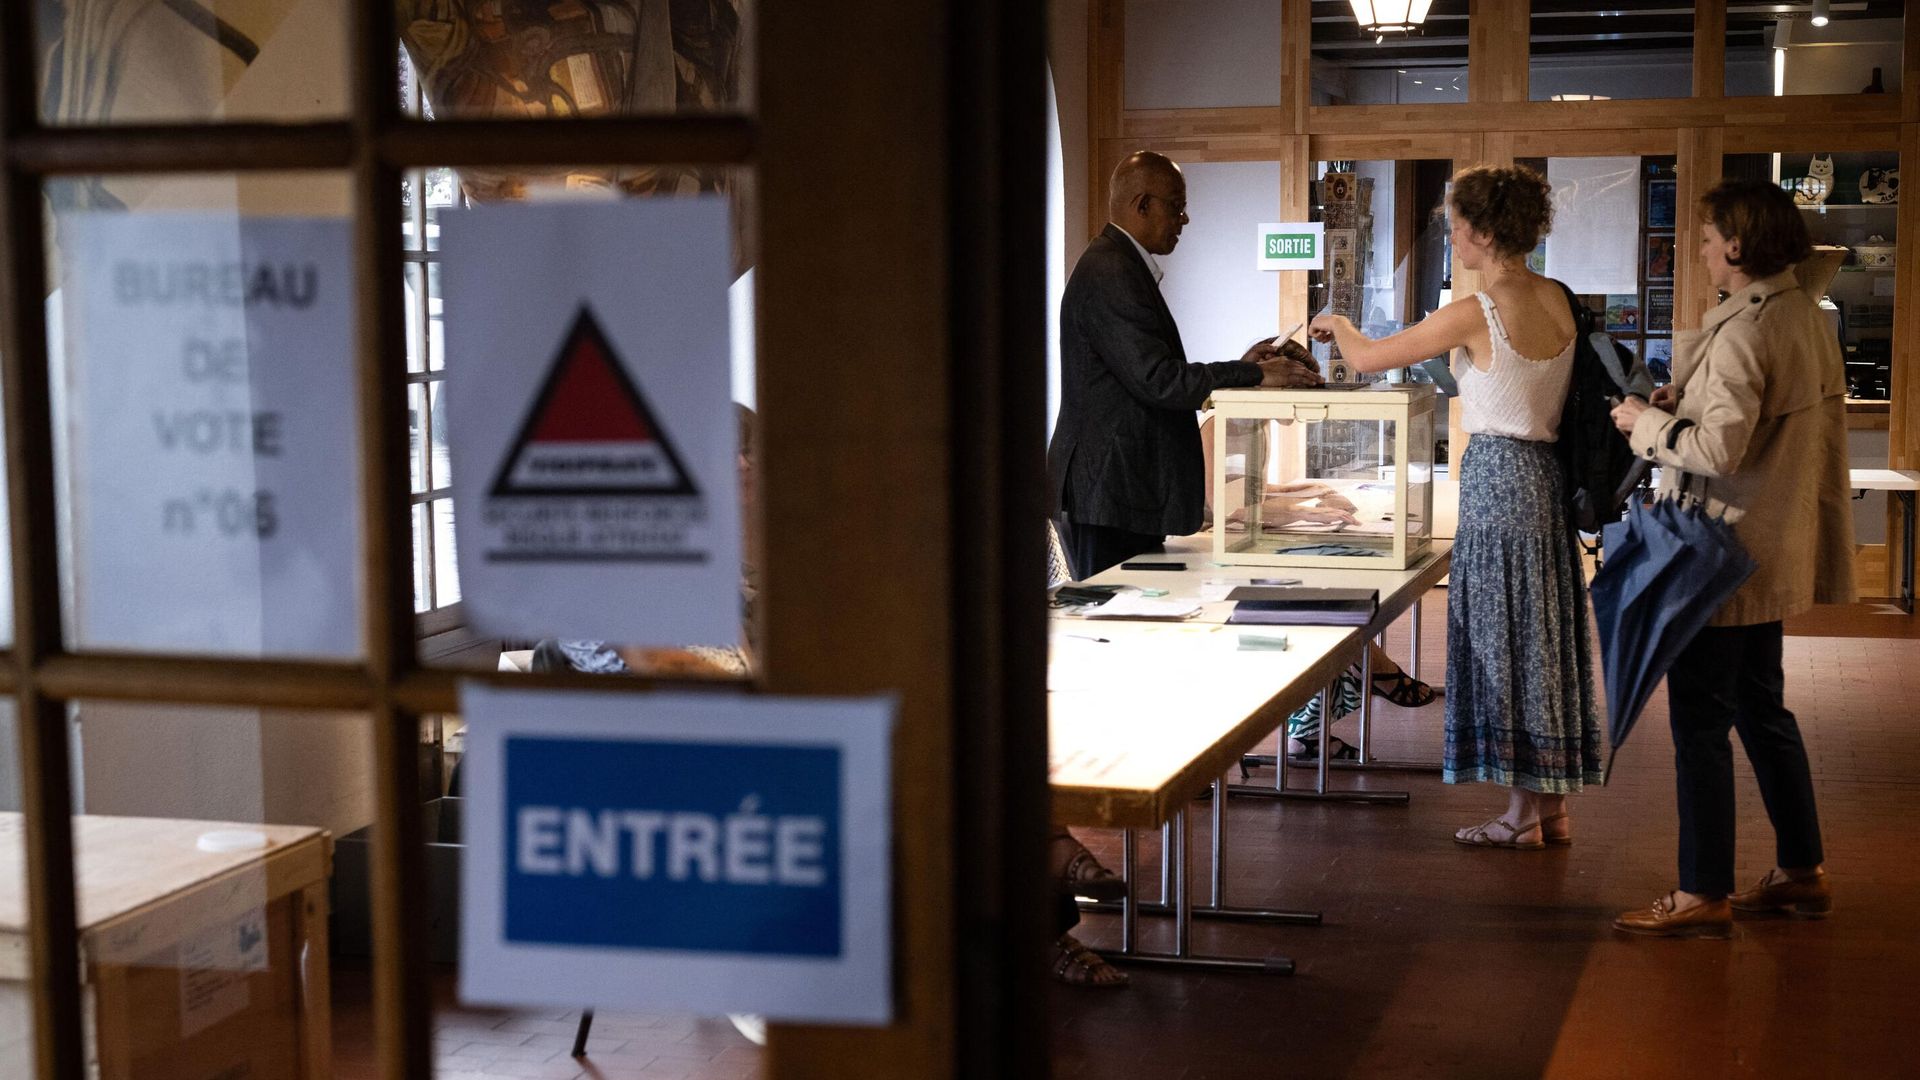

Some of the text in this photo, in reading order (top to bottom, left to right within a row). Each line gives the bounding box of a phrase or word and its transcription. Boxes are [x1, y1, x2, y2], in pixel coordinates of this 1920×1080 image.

[1269, 238, 1311, 254] SORTIE
[114, 259, 318, 309] BUREAU
[183, 337, 249, 381] DE
[152, 411, 284, 456] VOTE
[516, 794, 828, 887] ENTRÉE
